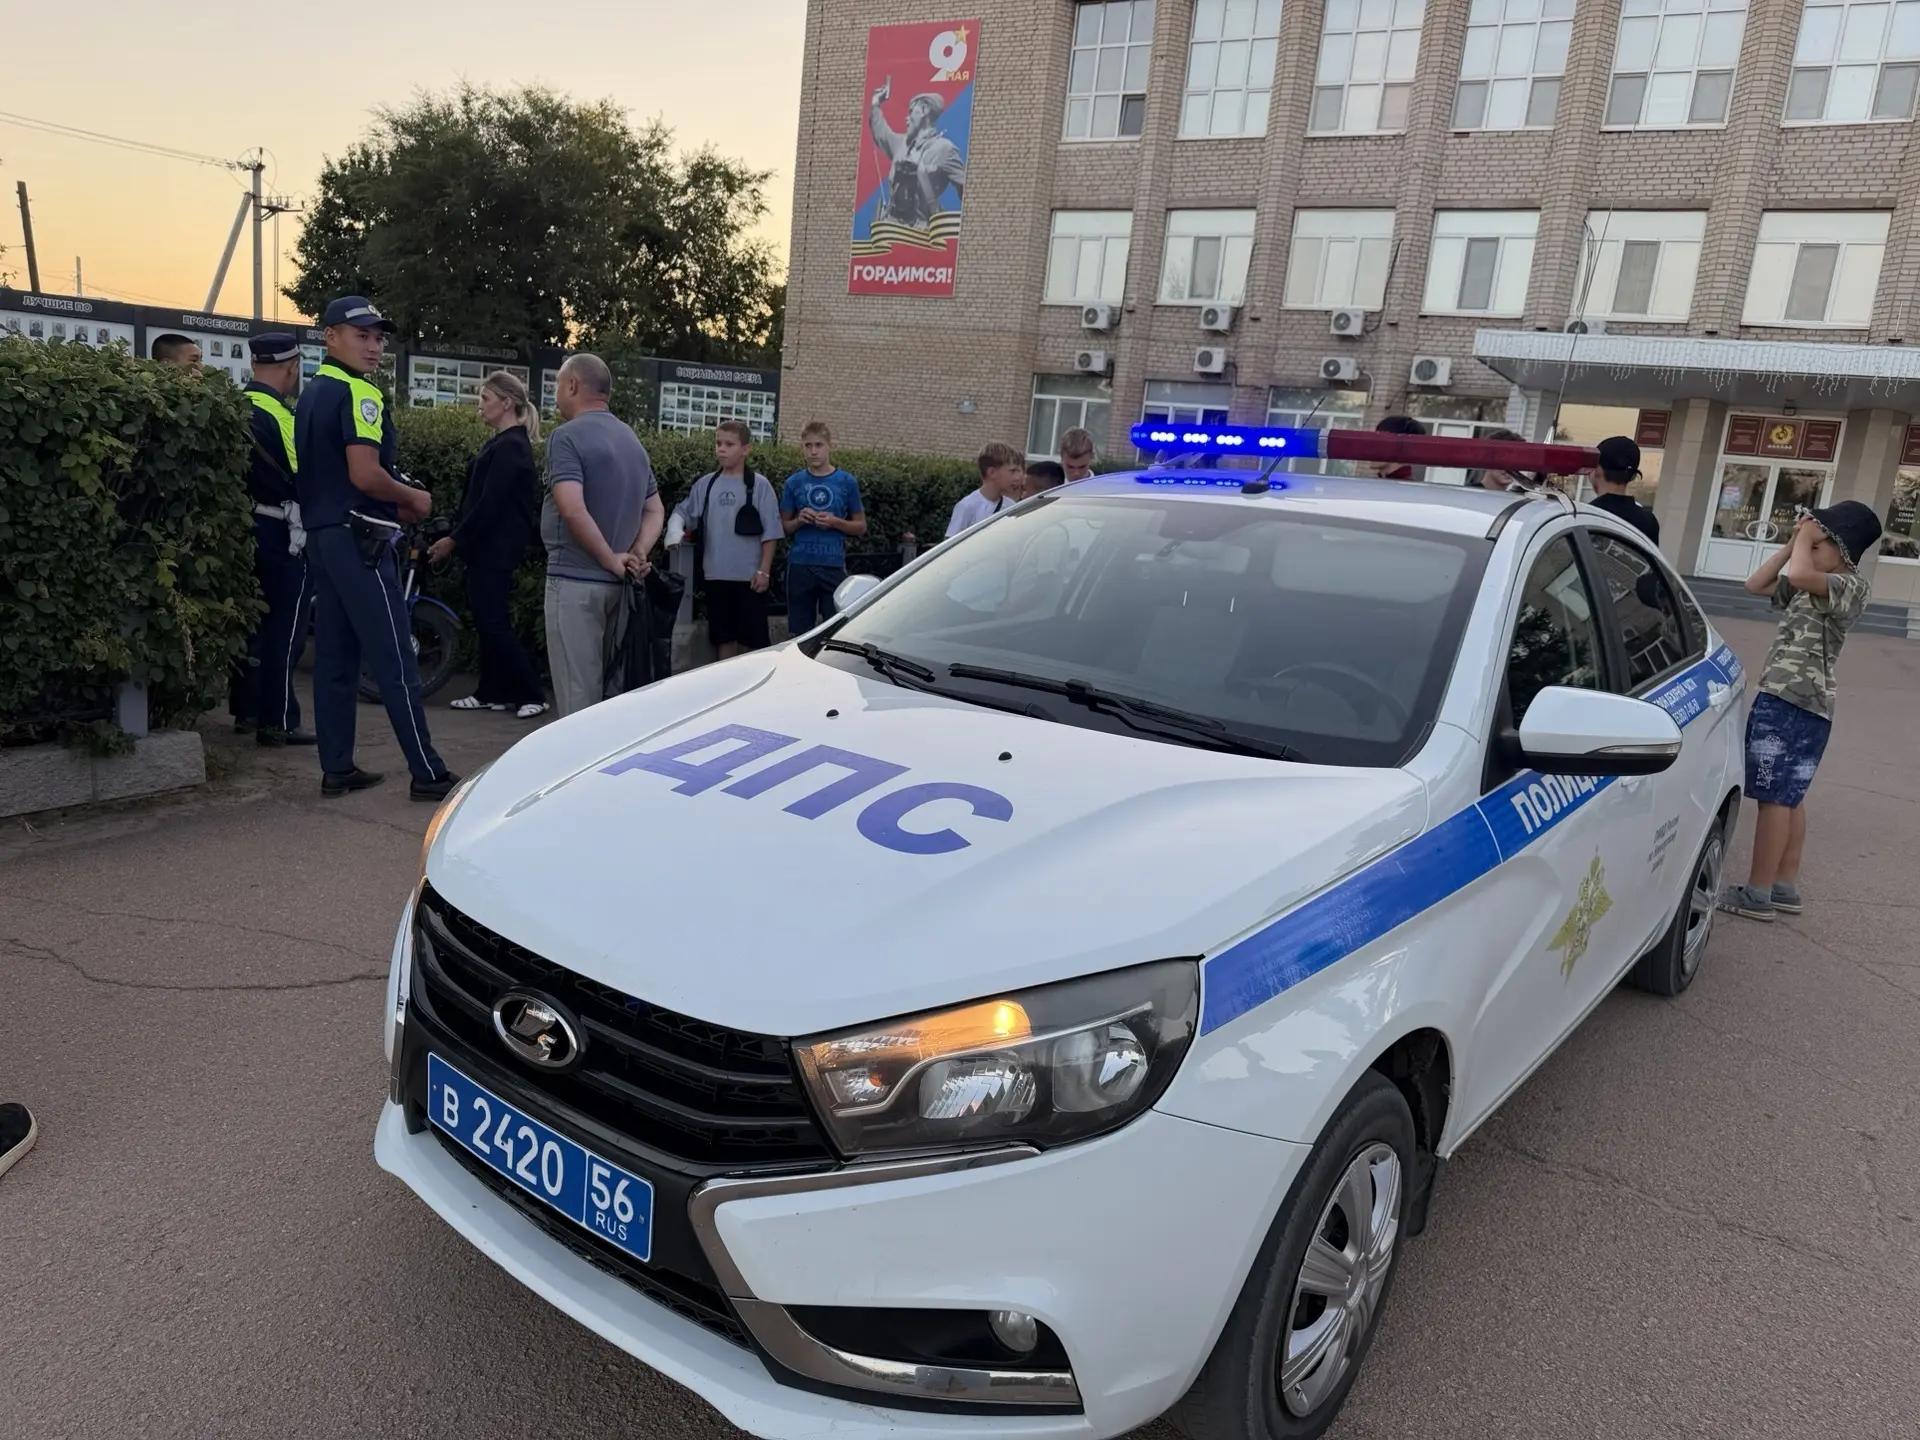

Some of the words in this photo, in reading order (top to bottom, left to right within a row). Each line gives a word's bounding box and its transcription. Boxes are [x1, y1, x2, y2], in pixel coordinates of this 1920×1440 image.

[929, 31, 968, 82] 9
[946, 70, 970, 82] МАЯ
[852, 265, 953, 284] ГОРДИМСЯ!
[23, 295, 74, 311] ЛУЧШИЕ
[75, 301, 93, 313] ПО
[182, 315, 249, 332] ПРОФЕССИИ
[597, 723, 1014, 855] ДПС
[472, 1096, 564, 1197] 2420
[590, 1162, 635, 1224] 56
[595, 1210, 628, 1242] RUS
